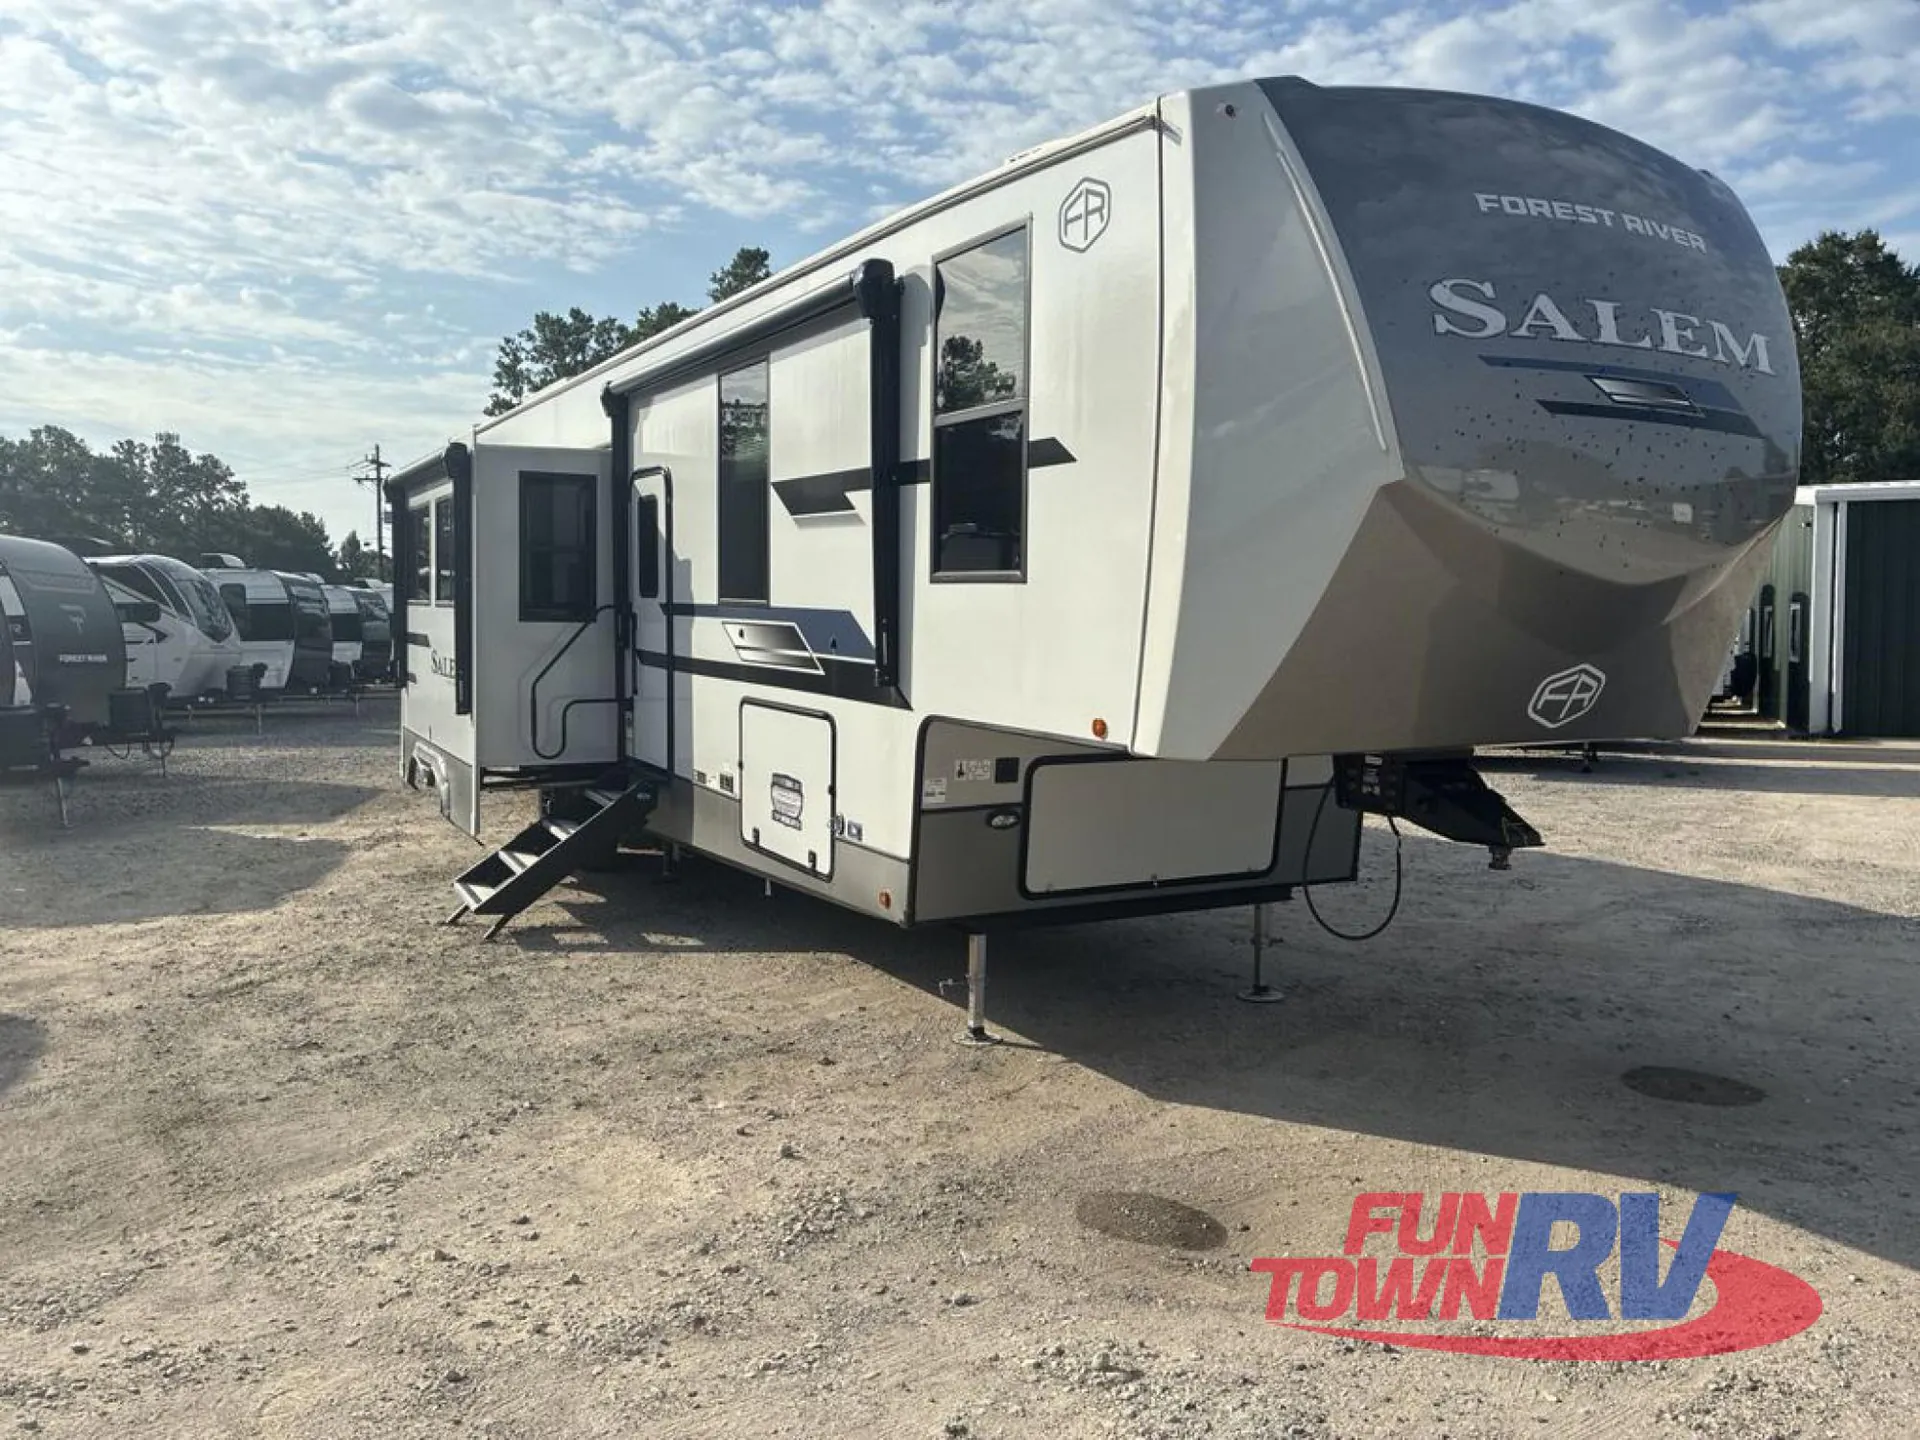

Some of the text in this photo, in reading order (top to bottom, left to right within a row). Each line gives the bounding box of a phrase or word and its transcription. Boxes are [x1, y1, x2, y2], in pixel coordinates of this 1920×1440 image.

[1474, 192, 1708, 254] FOREST RIVER
[1429, 277, 1777, 376] SALEM
[430, 648, 457, 679] SALE
